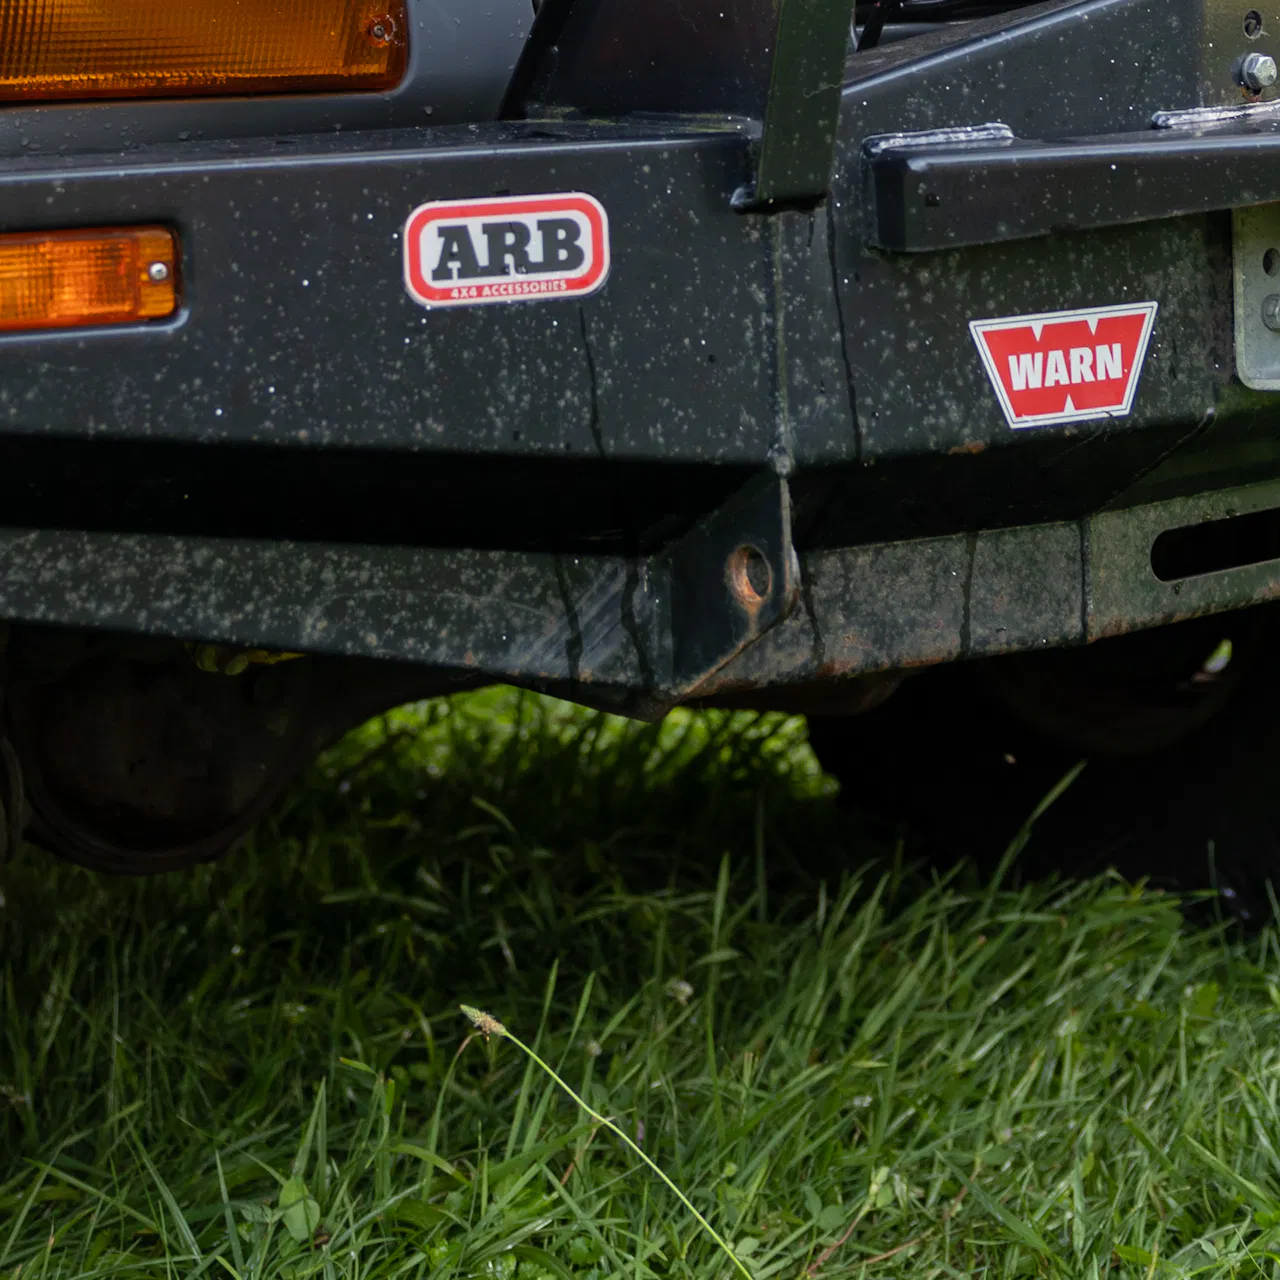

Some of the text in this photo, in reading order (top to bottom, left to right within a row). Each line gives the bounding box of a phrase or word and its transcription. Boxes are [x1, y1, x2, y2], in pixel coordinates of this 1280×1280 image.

[431, 218, 585, 282] ARB
[450, 279, 568, 300] 4X4 ACCESSORIES
[1008, 342, 1123, 392] WARN
